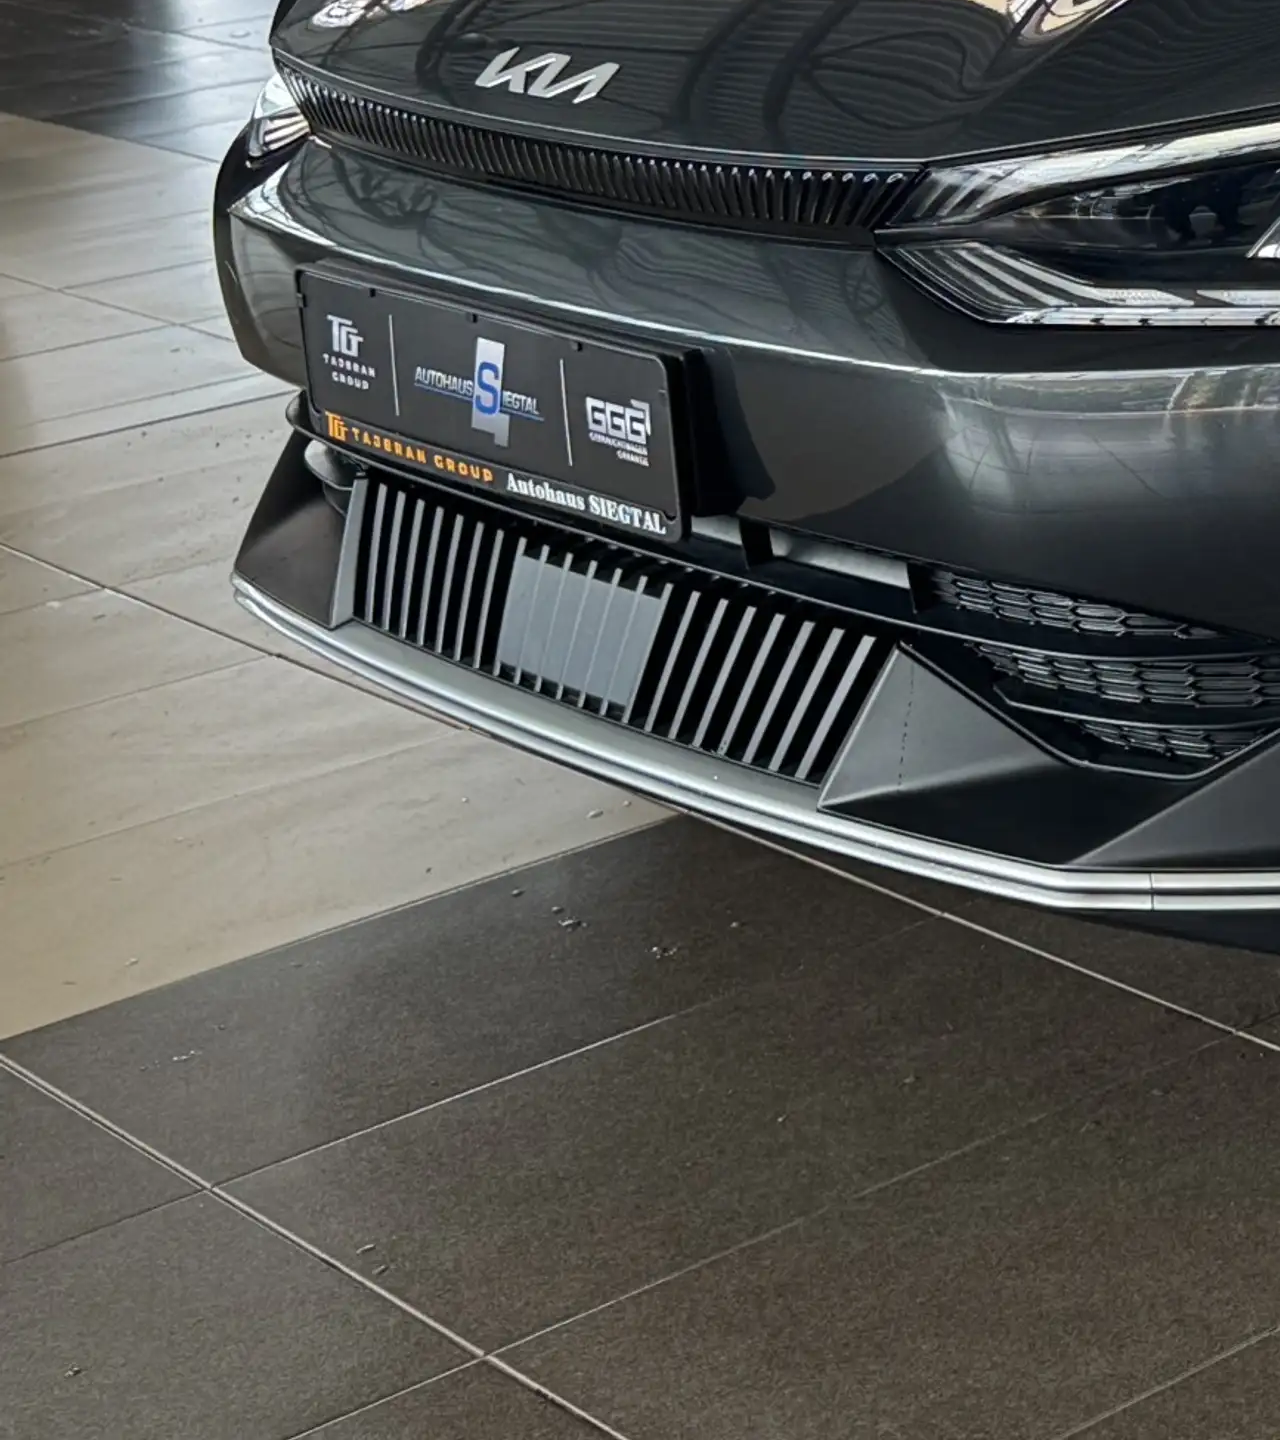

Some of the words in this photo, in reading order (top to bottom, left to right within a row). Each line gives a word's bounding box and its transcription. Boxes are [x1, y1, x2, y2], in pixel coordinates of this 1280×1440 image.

[475, 46, 620, 104] KIA
[331, 371, 370, 390] GROUP
[414, 366, 474, 397] AUTOHAUS
[434, 455, 493, 482] GROUP
[506, 472, 585, 511] Autohaus
[588, 494, 667, 535] SIEGTAL
